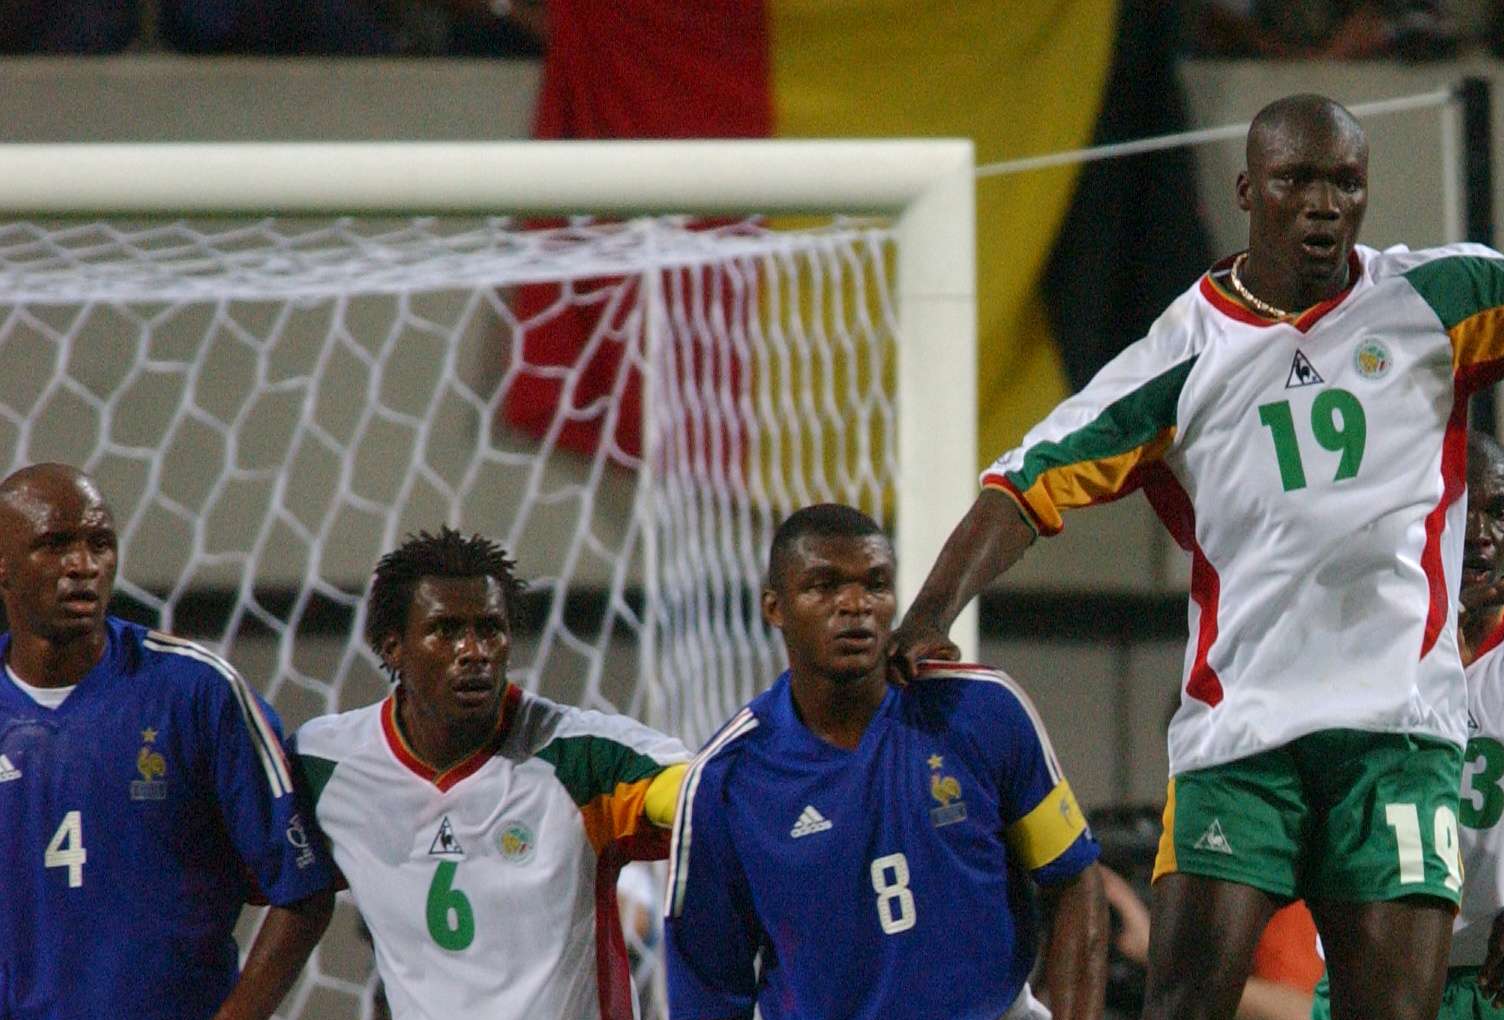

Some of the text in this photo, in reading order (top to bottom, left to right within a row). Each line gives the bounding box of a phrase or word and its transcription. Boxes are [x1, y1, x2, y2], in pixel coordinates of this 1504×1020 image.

[1258, 388, 1367, 493] 19
[44, 810, 88, 889] 4
[1385, 803, 1463, 893] 19
[426, 860, 476, 952] 6
[871, 852, 917, 935] 8
